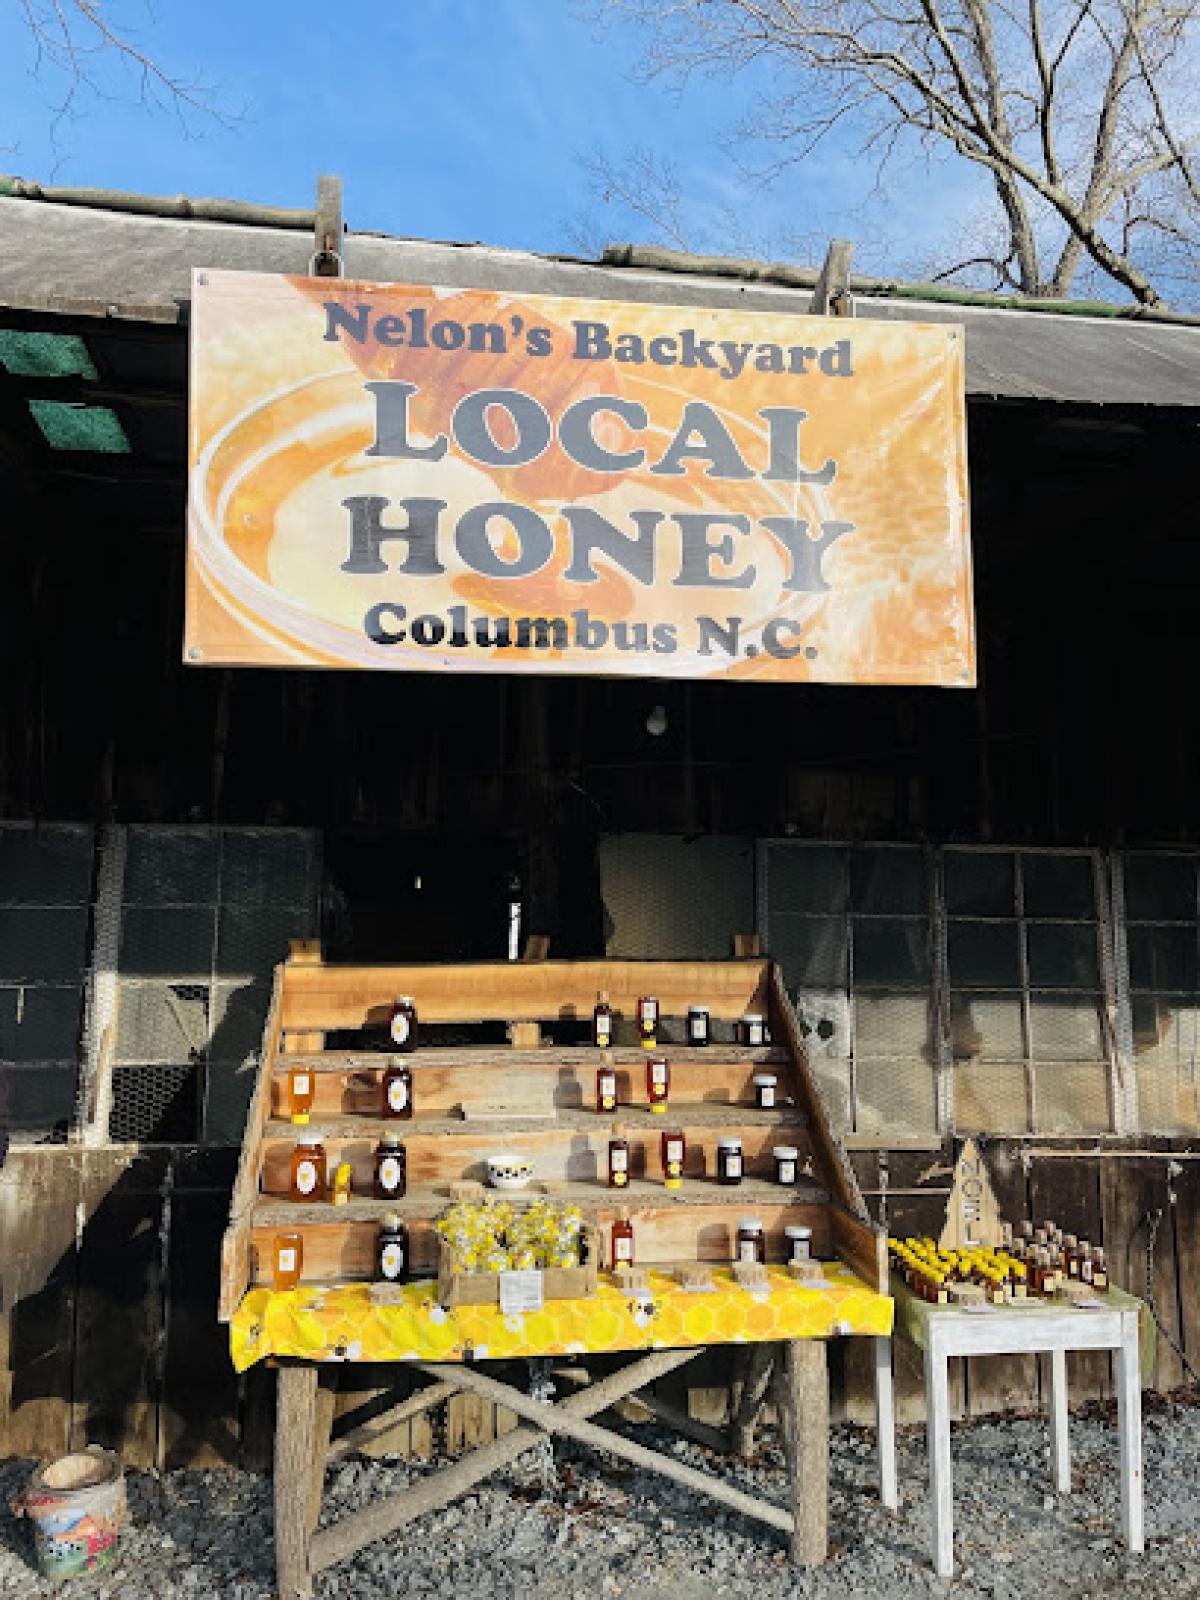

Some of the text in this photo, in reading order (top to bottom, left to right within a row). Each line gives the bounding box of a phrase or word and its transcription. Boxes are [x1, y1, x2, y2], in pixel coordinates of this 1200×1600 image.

[323, 303, 854, 379] Nelon's Backyard
[365, 381, 836, 484] LOCAL
[341, 496, 854, 591] HONEY
[364, 603, 818, 659] Columbus N.C.
[961, 1158, 983, 1246] NOEL
